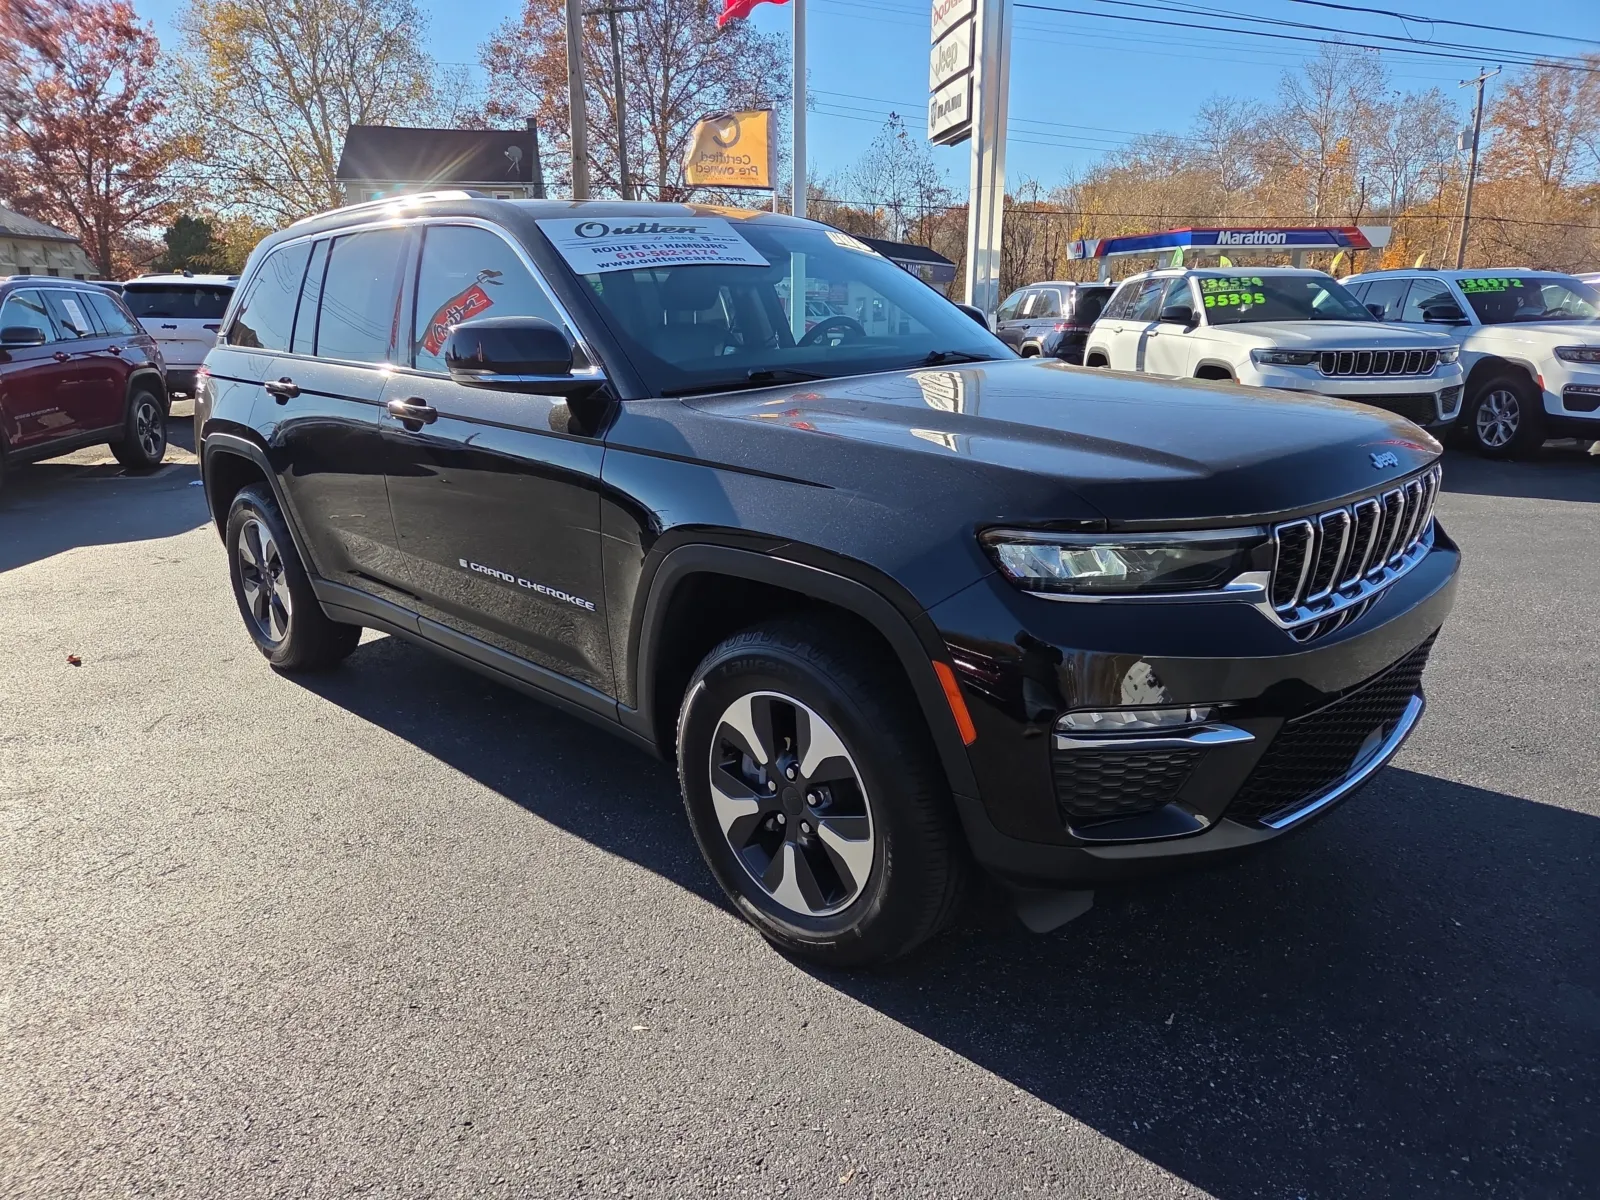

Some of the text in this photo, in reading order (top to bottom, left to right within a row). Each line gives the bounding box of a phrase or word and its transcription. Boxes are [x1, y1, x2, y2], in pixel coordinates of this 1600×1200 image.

[933, 0, 963, 27] DODG
[935, 42, 958, 77] Jeep
[937, 93, 962, 119] RAM
[574, 222, 697, 238] Outten
[1216, 230, 1287, 245] Marathon
[591, 244, 640, 254] ROUTE
[616, 249, 719, 260] 610-562-5174
[597, 256, 747, 269] www.outtencars.com
[1204, 292, 1266, 308] 35395
[1369, 451, 1399, 469] Jeep
[470, 562, 596, 612] GRAND CHEROKEE
